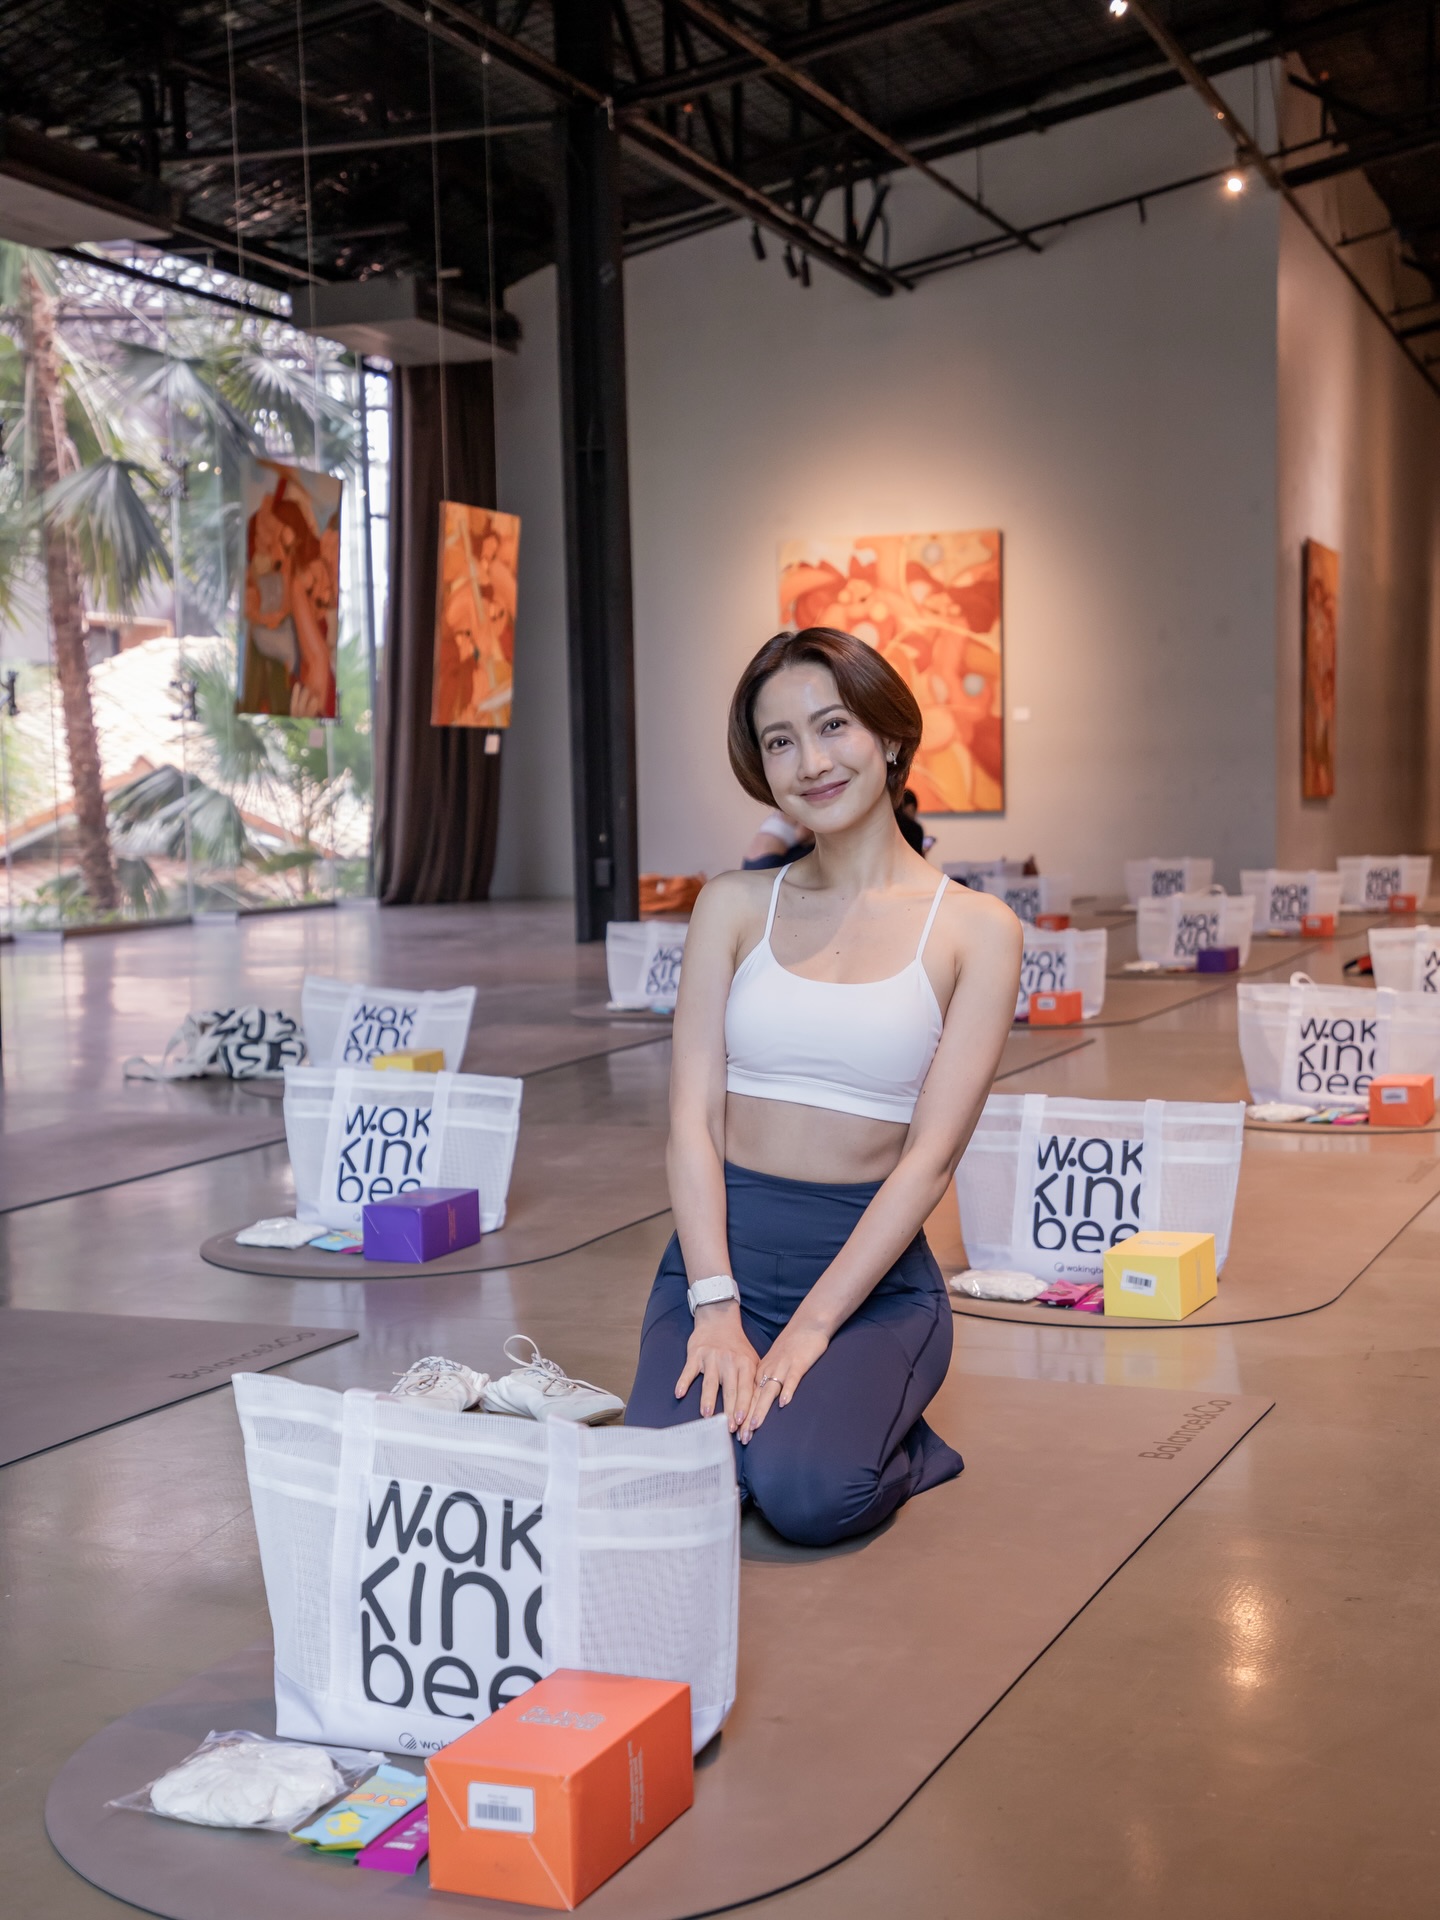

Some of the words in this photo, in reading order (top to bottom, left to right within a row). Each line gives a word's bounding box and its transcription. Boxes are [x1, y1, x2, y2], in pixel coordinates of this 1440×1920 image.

[1299, 1040, 1375, 1072] kin
[341, 1127, 428, 1176] kin
[1034, 1162, 1141, 1221] kin
[167, 1331, 317, 1380] Balance&Co
[1137, 1399, 1232, 1460] Balance&Co
